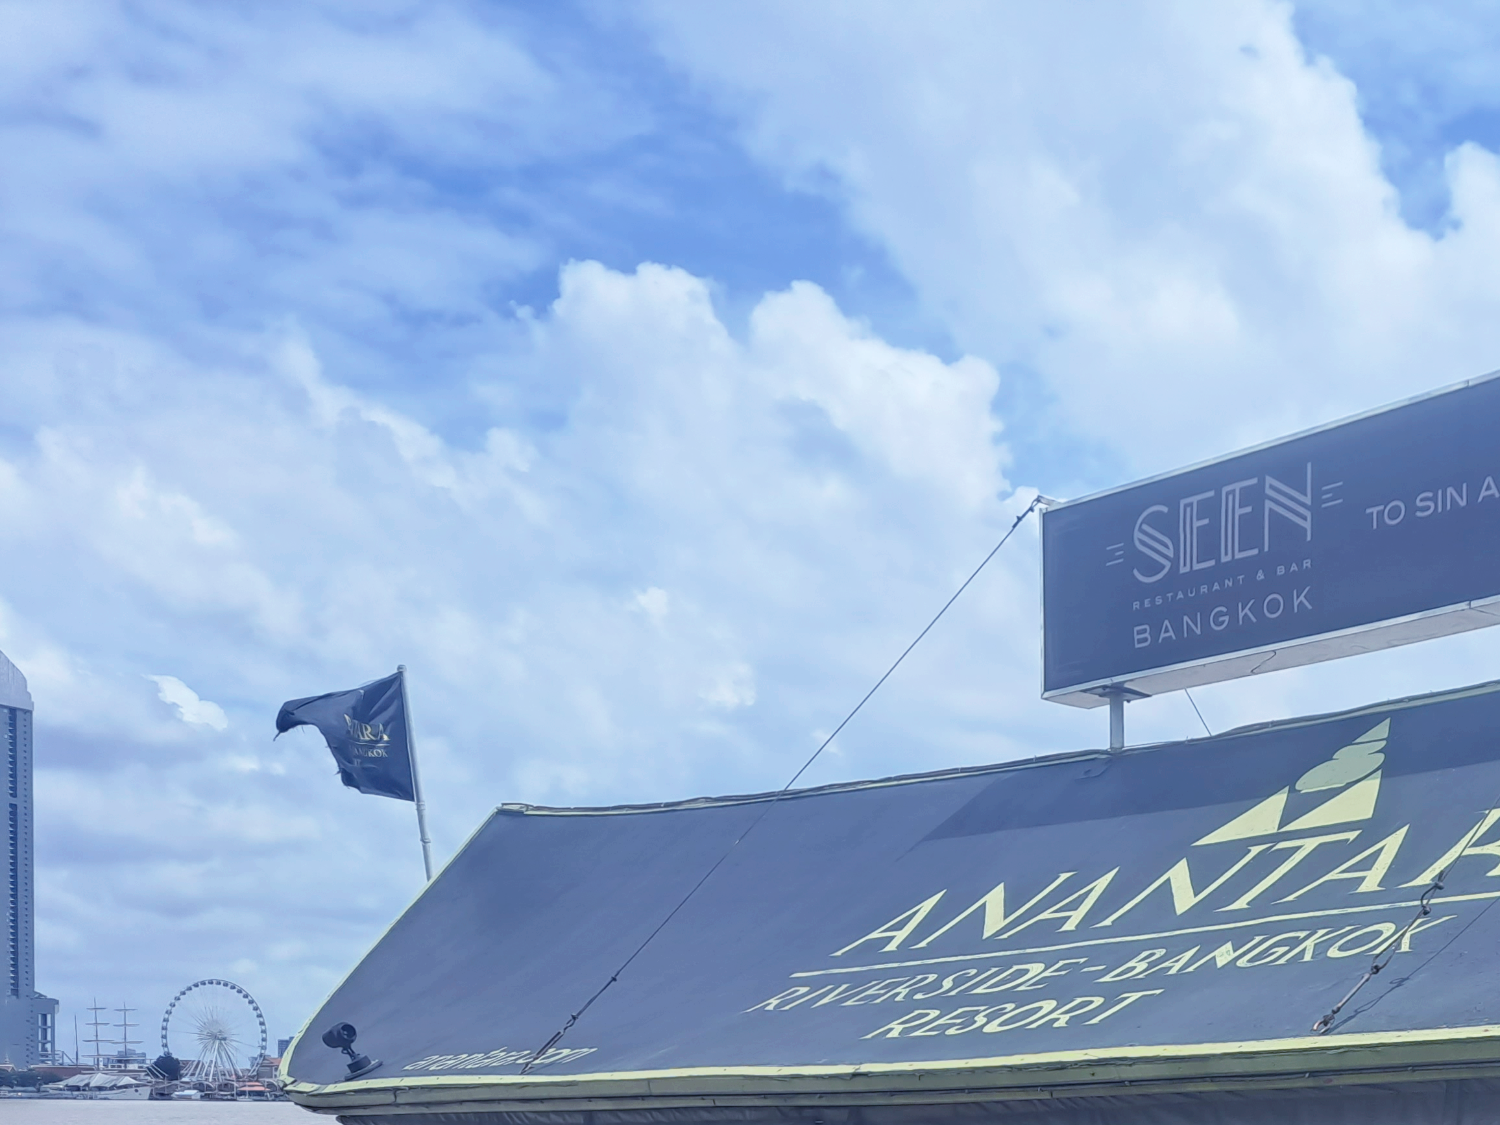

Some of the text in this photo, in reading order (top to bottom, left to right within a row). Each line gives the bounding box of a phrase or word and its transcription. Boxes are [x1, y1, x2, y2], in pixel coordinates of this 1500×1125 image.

[1133, 462, 1312, 583] SEEN
[1365, 501, 1406, 530] TO
[1415, 483, 1468, 518] SIN
[1132, 559, 1312, 611] RESTAURANT & BAR
[1133, 586, 1313, 649] BANGKOK
[859, 988, 1165, 1040] RESORT
[402, 1046, 599, 1071] anantara.com
